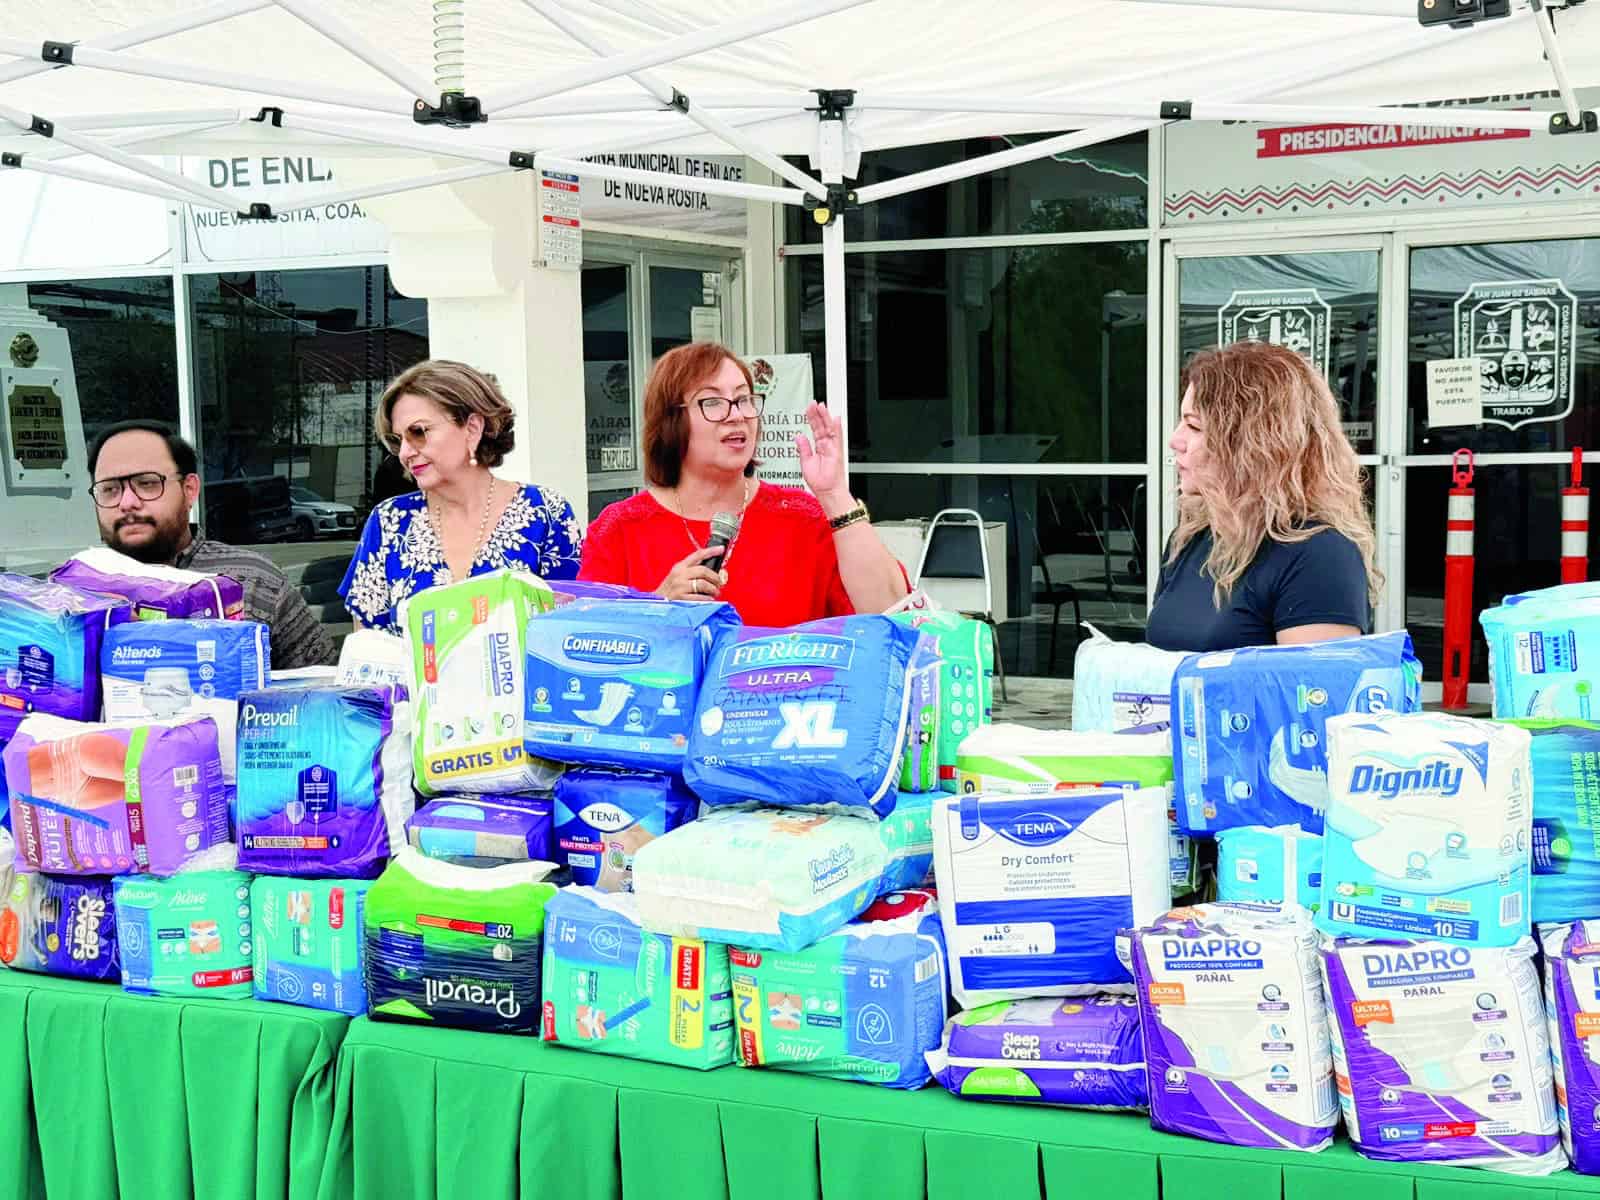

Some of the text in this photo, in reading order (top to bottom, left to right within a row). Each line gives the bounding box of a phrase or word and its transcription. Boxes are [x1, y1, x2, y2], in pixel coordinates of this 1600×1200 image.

[1280, 123, 1505, 152] PRESIDENCIA MUNICIPAL
[208, 157, 250, 188] DE
[619, 153, 683, 176] MUNICIPAL
[685, 158, 700, 178] DE
[604, 178, 621, 199] DE
[625, 181, 665, 204] NUEVA
[325, 202, 367, 220] COA
[1434, 366, 1459, 374] FAVOR
[1444, 387, 1464, 395] ESTA
[1492, 407, 1534, 416] TRABAJO
[563, 635, 647, 656] CONFIHABILE
[1519, 638, 1529, 648] 12
[113, 646, 163, 658] Attends
[495, 631, 514, 695] DIAPRO
[748, 671, 813, 686] ULTRA
[243, 704, 298, 727] Prevail
[772, 700, 849, 749] XL
[431, 752, 494, 775] GRATIS
[703, 756, 717, 767] 20
[1349, 764, 1463, 801] Dignity
[588, 810, 621, 824] TENA
[20, 801, 40, 863] Depend
[1014, 822, 1057, 835] TENA
[243, 835, 254, 848] 14
[1001, 852, 1075, 868] Dry Comfort
[1337, 903, 1350, 917] U
[330, 912, 341, 925] M
[72, 894, 90, 961] Overs
[85, 898, 106, 960] Sleep
[498, 924, 512, 938] 20
[565, 925, 577, 943] 12
[1404, 924, 1432, 934] Unisex
[1434, 922, 1453, 937] 10
[1161, 939, 1262, 959] DIAPRO
[746, 953, 759, 964] M
[1169, 961, 1207, 970] PROTECCIÓN
[1225, 960, 1258, 969] CONFIABLE
[1363, 947, 1471, 976] DIAPRO
[194, 972, 206, 985] M
[231, 970, 243, 982] M
[682, 947, 701, 1013] GRATIS 2
[869, 975, 888, 988] 12
[1195, 971, 1235, 983] PAÑAL
[312, 982, 323, 998] 10
[425, 977, 521, 1018] Prevail
[1151, 986, 1181, 995] ULTRA
[1403, 985, 1446, 998] PAÑAL
[737, 994, 753, 1023] 2
[1354, 1003, 1389, 1013] ULTRA
[1577, 1016, 1600, 1026] ULT
[1002, 1031, 1040, 1047] Sleep
[741, 1032, 757, 1066] GRATI
[776, 1042, 824, 1062] Active
[1000, 1045, 1041, 1060] Overs
[1383, 1128, 1400, 1140] 10
